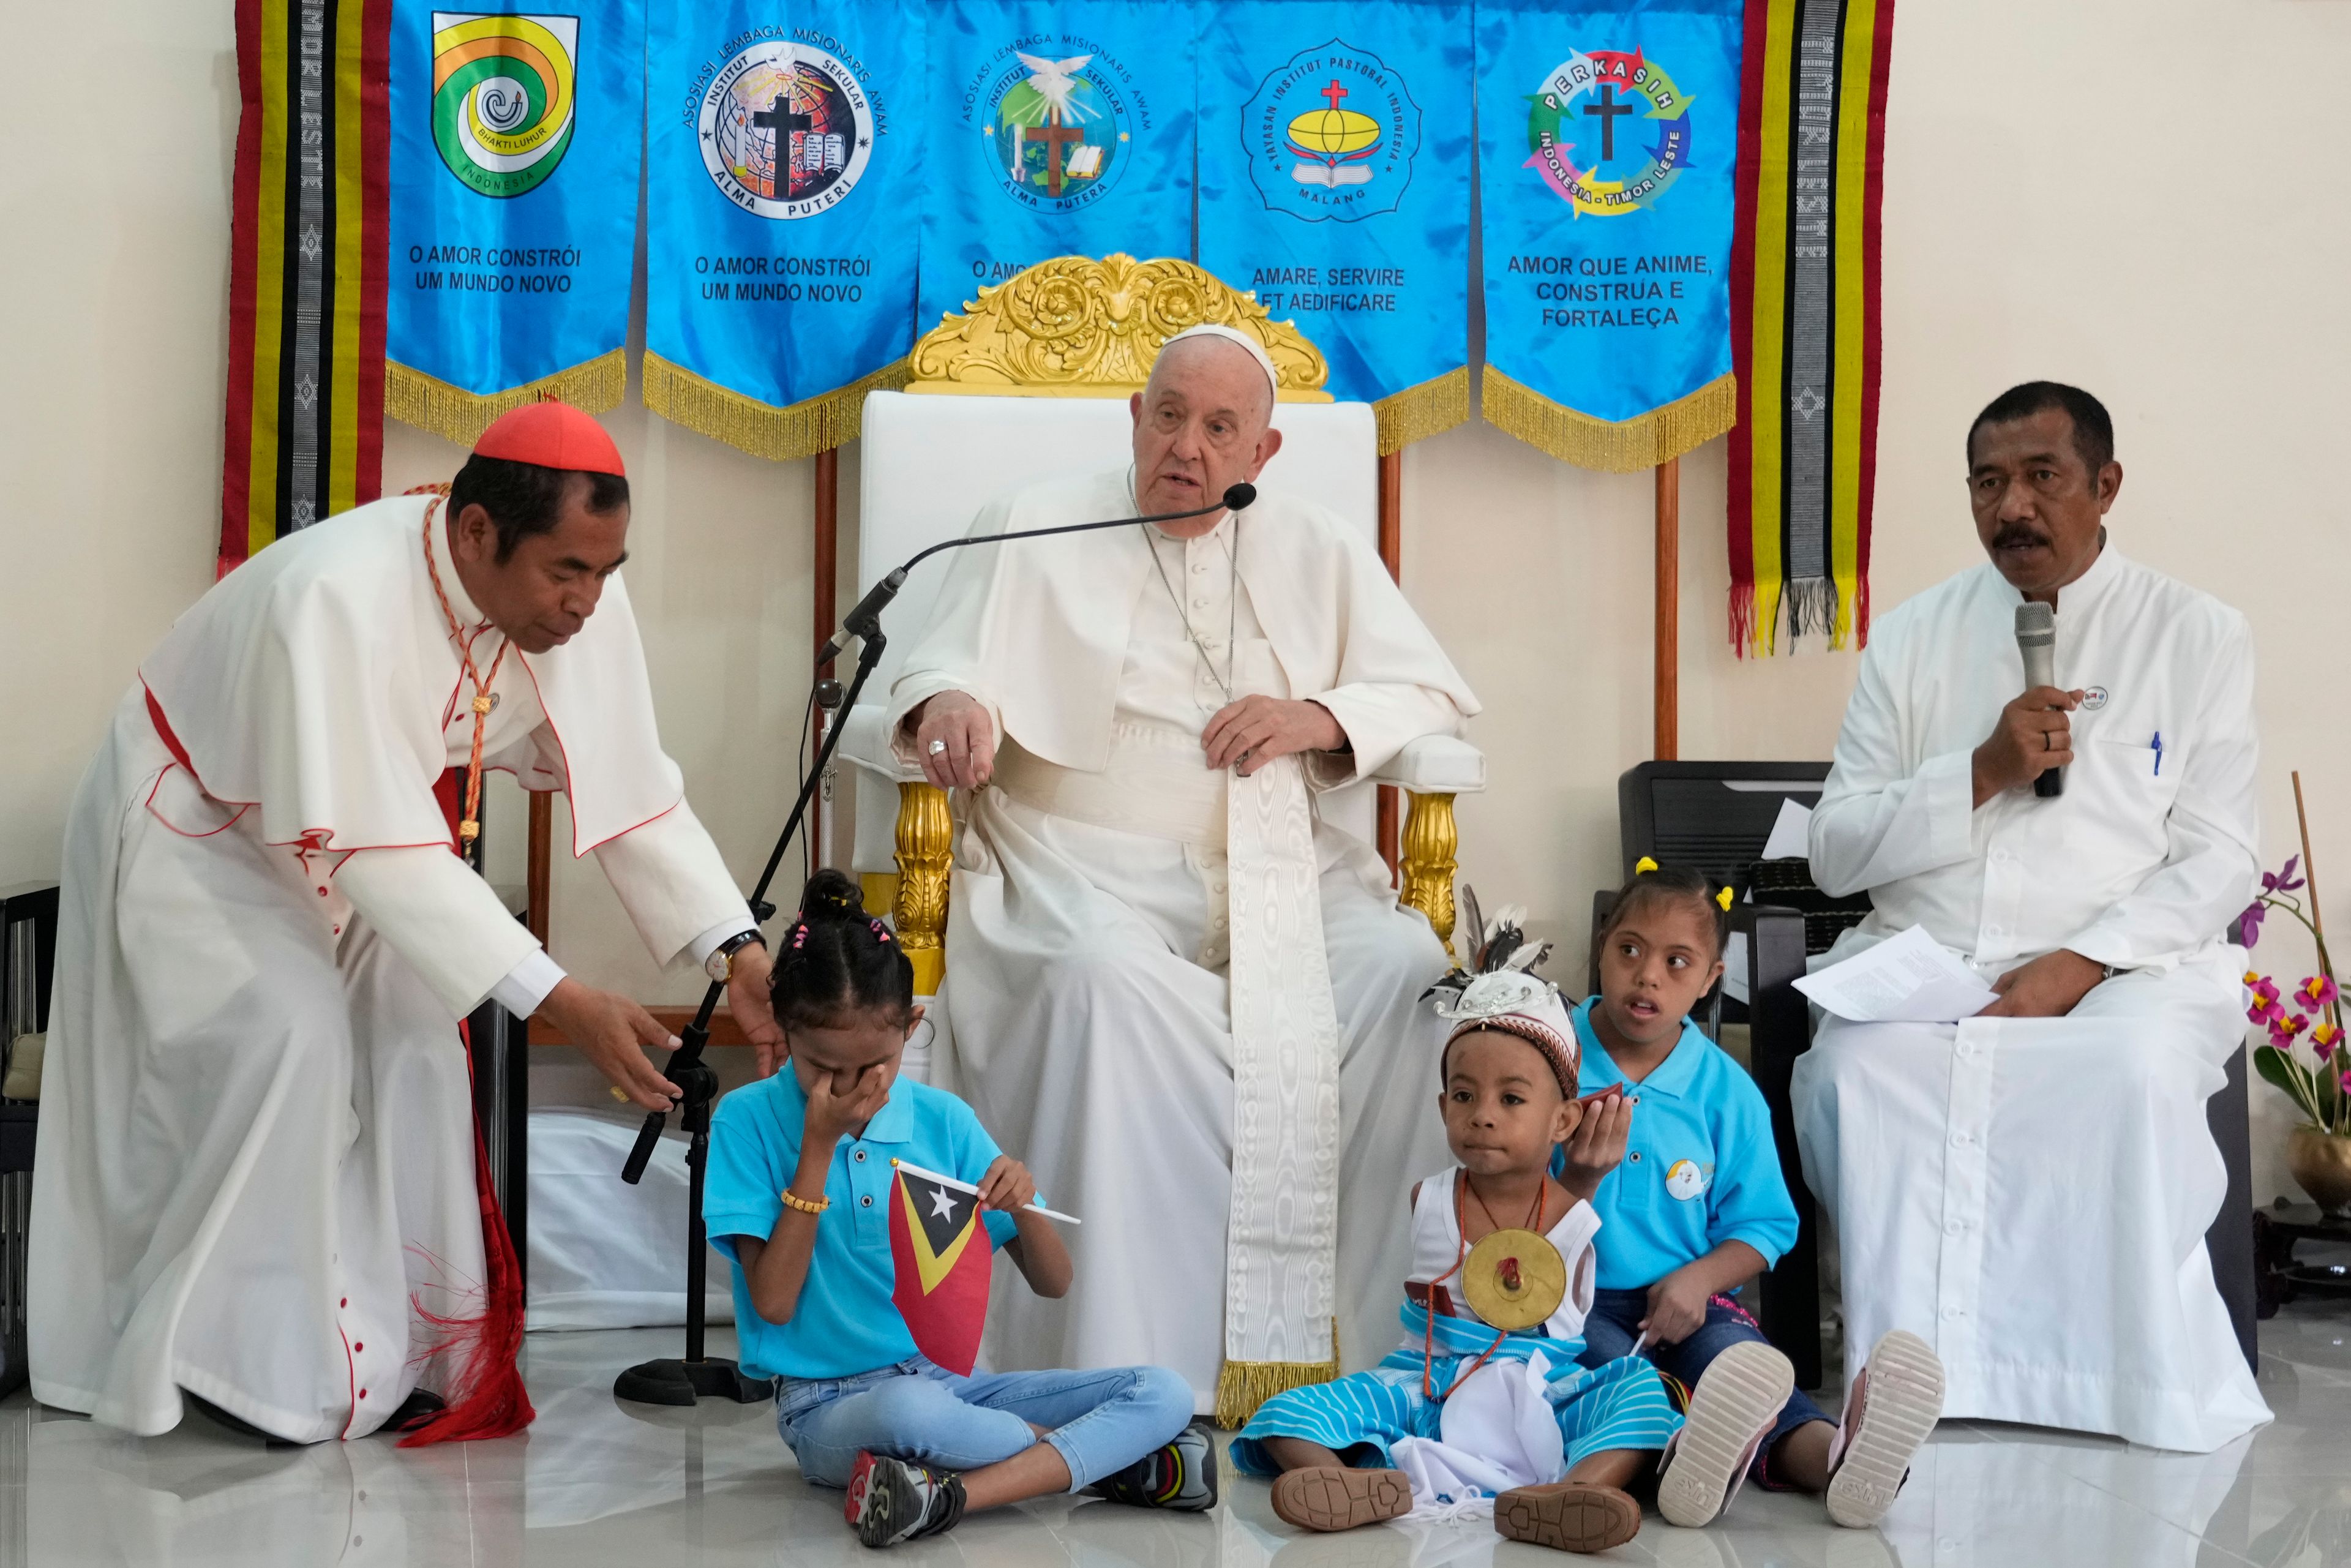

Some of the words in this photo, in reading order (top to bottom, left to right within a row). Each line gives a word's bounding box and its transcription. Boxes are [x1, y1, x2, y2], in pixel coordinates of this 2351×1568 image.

[683, 61, 716, 129] ASOSIASI
[718, 25, 784, 59] LEMBAGA
[793, 27, 870, 83] MISIONARIS
[868, 90, 888, 137] AWAM
[708, 55, 749, 106] INSTITUT
[822, 59, 863, 110] SEKULAR
[962, 62, 991, 122] ASOSIASI
[993, 34, 1052, 62] LEMBAGA
[1061, 34, 1132, 84] MISIONARIS
[1132, 90, 1152, 131] AWAM
[989, 67, 1026, 108] INSTITUT
[1085, 70, 1123, 115] SEKULAR
[1543, 59, 1674, 111] PERKASIH
[1262, 106, 1279, 162] YAYASAN
[1273, 59, 1322, 101] INSTITUT
[1330, 58, 1387, 90] PASTORAL
[1387, 92, 1404, 160] INDONESIA
[301, 90, 323, 189] LESTE
[478, 127, 511, 149] BHAKTI
[514, 127, 547, 149] LUHUR
[463, 163, 534, 190] INDONESIA
[1539, 132, 1592, 204] INDONESIA
[1605, 180, 1655, 206] TIMOR
[1654, 130, 1679, 179] LESTE
[714, 171, 755, 209] ALMA
[789, 179, 852, 216] PUTERI
[1003, 181, 1037, 206] ALMA
[1056, 183, 1107, 209] PUTERA
[1299, 188, 1365, 205] MALANG
[1796, 160, 1828, 257] LESTE
[410, 246, 422, 263] O
[427, 246, 481, 264] AMOR
[487, 244, 580, 266] CONSTRÓI
[696, 257, 708, 274] O
[713, 257, 768, 275] AMOR
[774, 255, 871, 277] CONSTRÓI
[1508, 256, 1572, 274] AMOR
[1580, 257, 1627, 277] QUE
[1635, 255, 1713, 277] ANIME,
[973, 260, 986, 278] O
[991, 262, 1032, 279] AM
[1253, 269, 1322, 288] AMARE,
[1327, 269, 1404, 287] SERVIRE
[416, 271, 443, 290] UM
[449, 272, 513, 292] MUNDO
[520, 275, 571, 293] NOVO
[702, 283, 729, 300] UM
[735, 284, 800, 301] MUNDO
[808, 285, 862, 302] NOVO
[1670, 281, 1684, 299] E
[1261, 294, 1282, 310] ET
[1289, 294, 1397, 312] AEDIFICARE
[1543, 307, 1679, 329] FORTALEÇA
